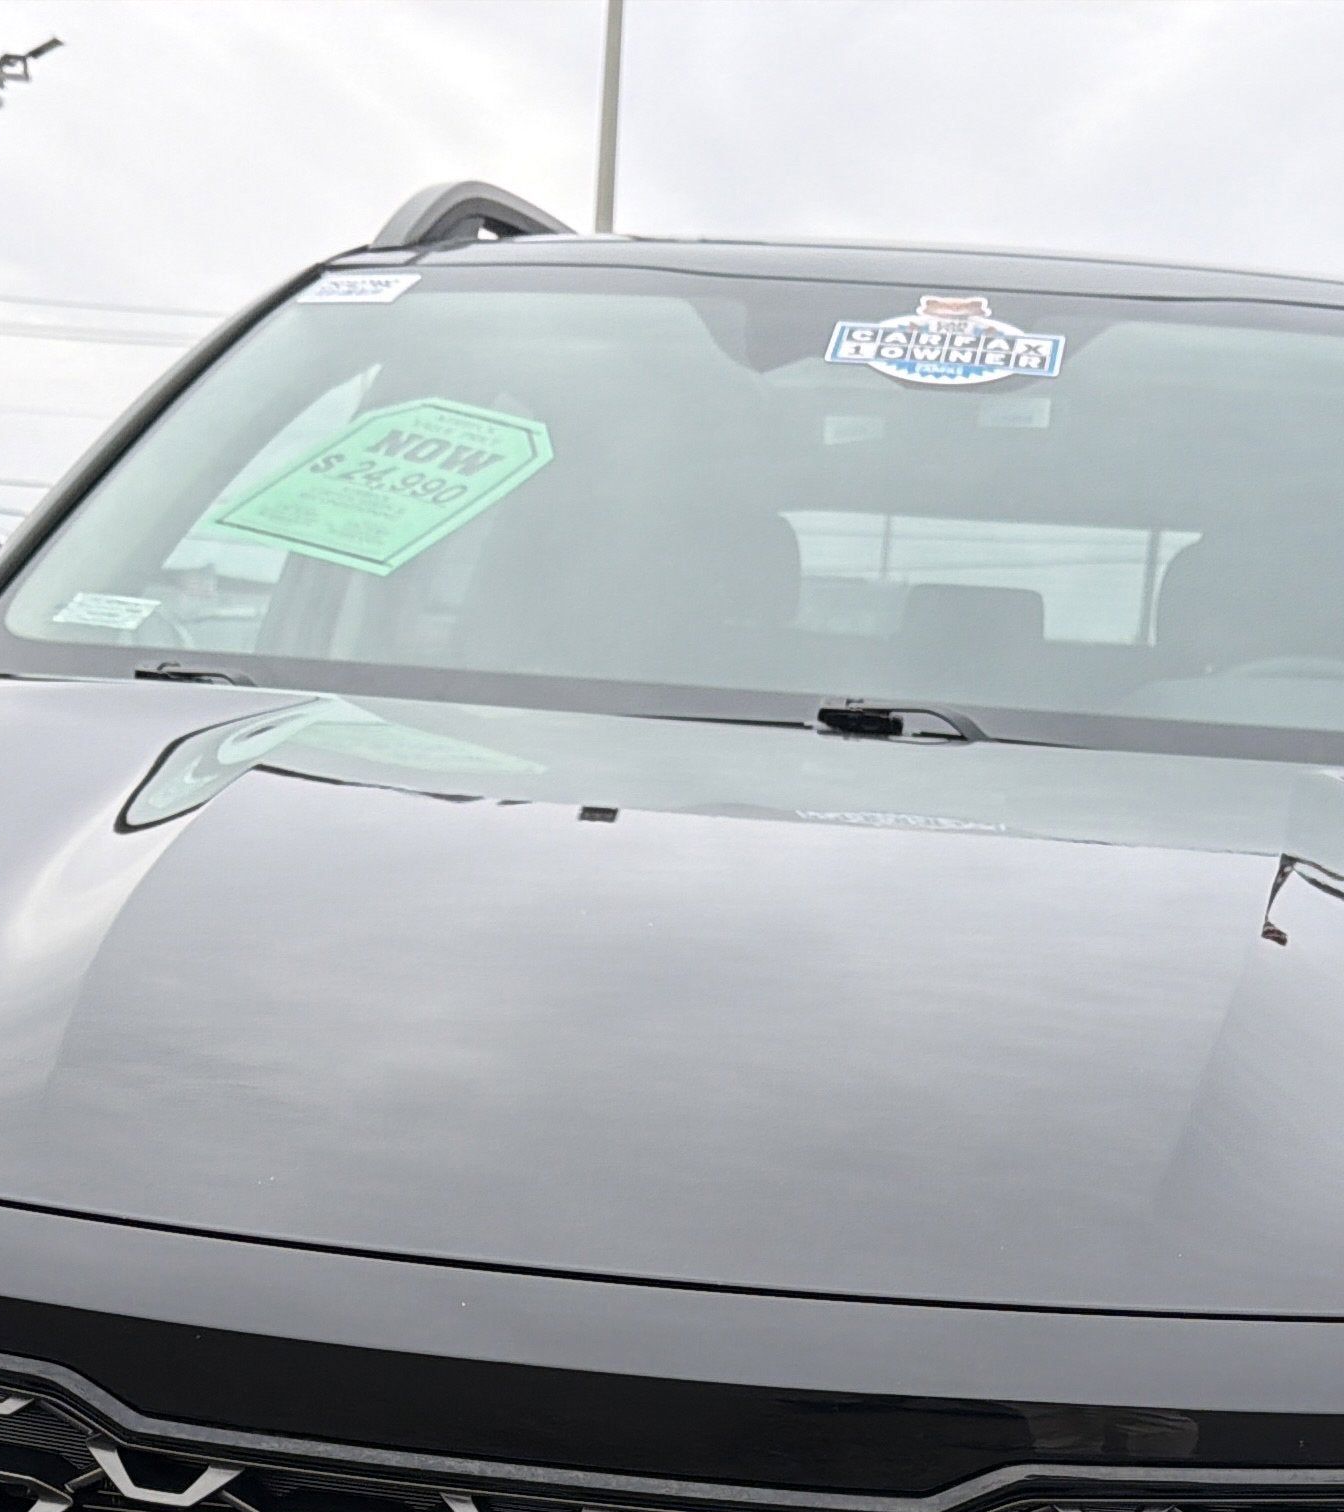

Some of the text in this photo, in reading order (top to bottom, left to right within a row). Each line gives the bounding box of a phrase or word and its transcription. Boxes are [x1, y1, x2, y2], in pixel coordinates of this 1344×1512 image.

[851, 330, 1044, 355] CARFAX
[880, 346, 1041, 369] OWNER
[367, 429, 505, 476] NOW
